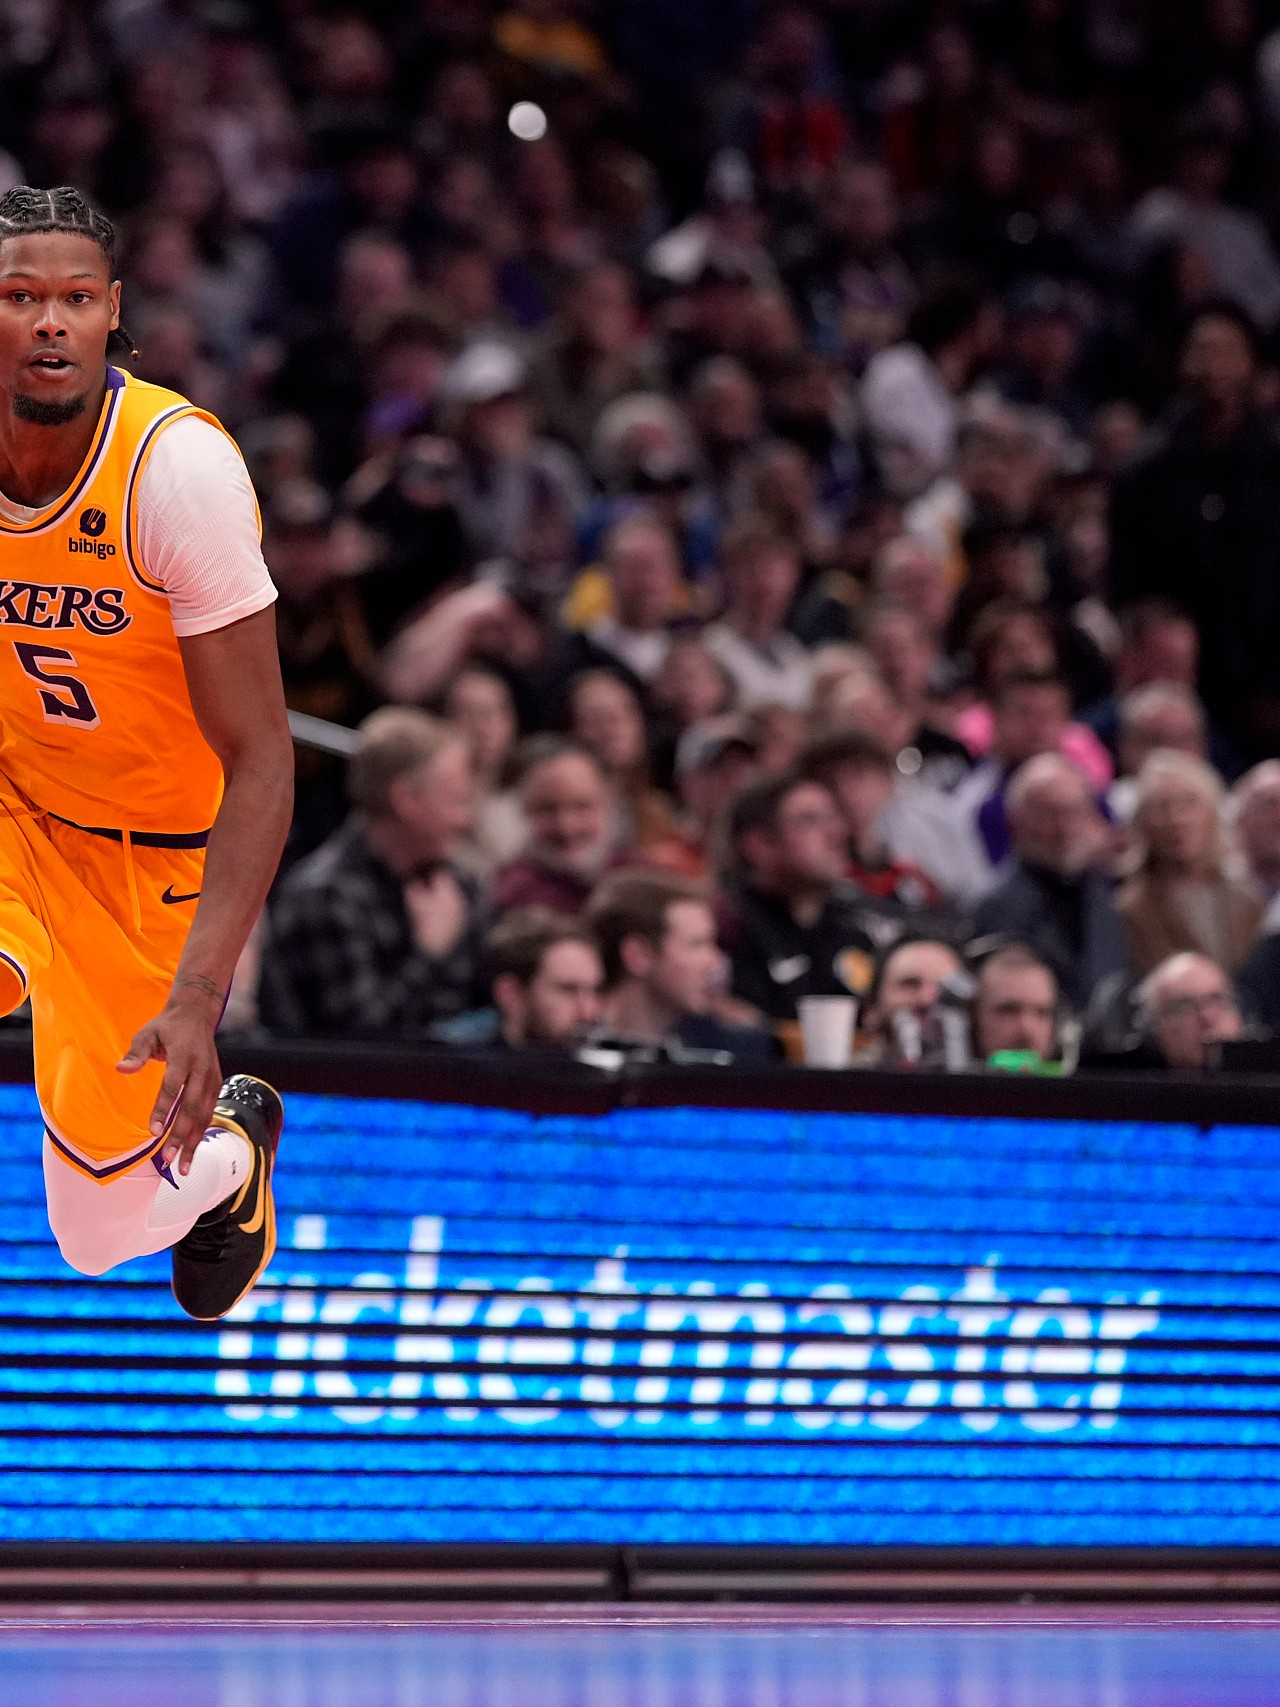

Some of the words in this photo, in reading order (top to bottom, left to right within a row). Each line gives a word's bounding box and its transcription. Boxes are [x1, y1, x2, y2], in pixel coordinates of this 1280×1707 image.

[68, 537, 116, 560] bibigo
[11, 641, 102, 731] 5
[214, 1213, 1162, 1434] ticketmaster
